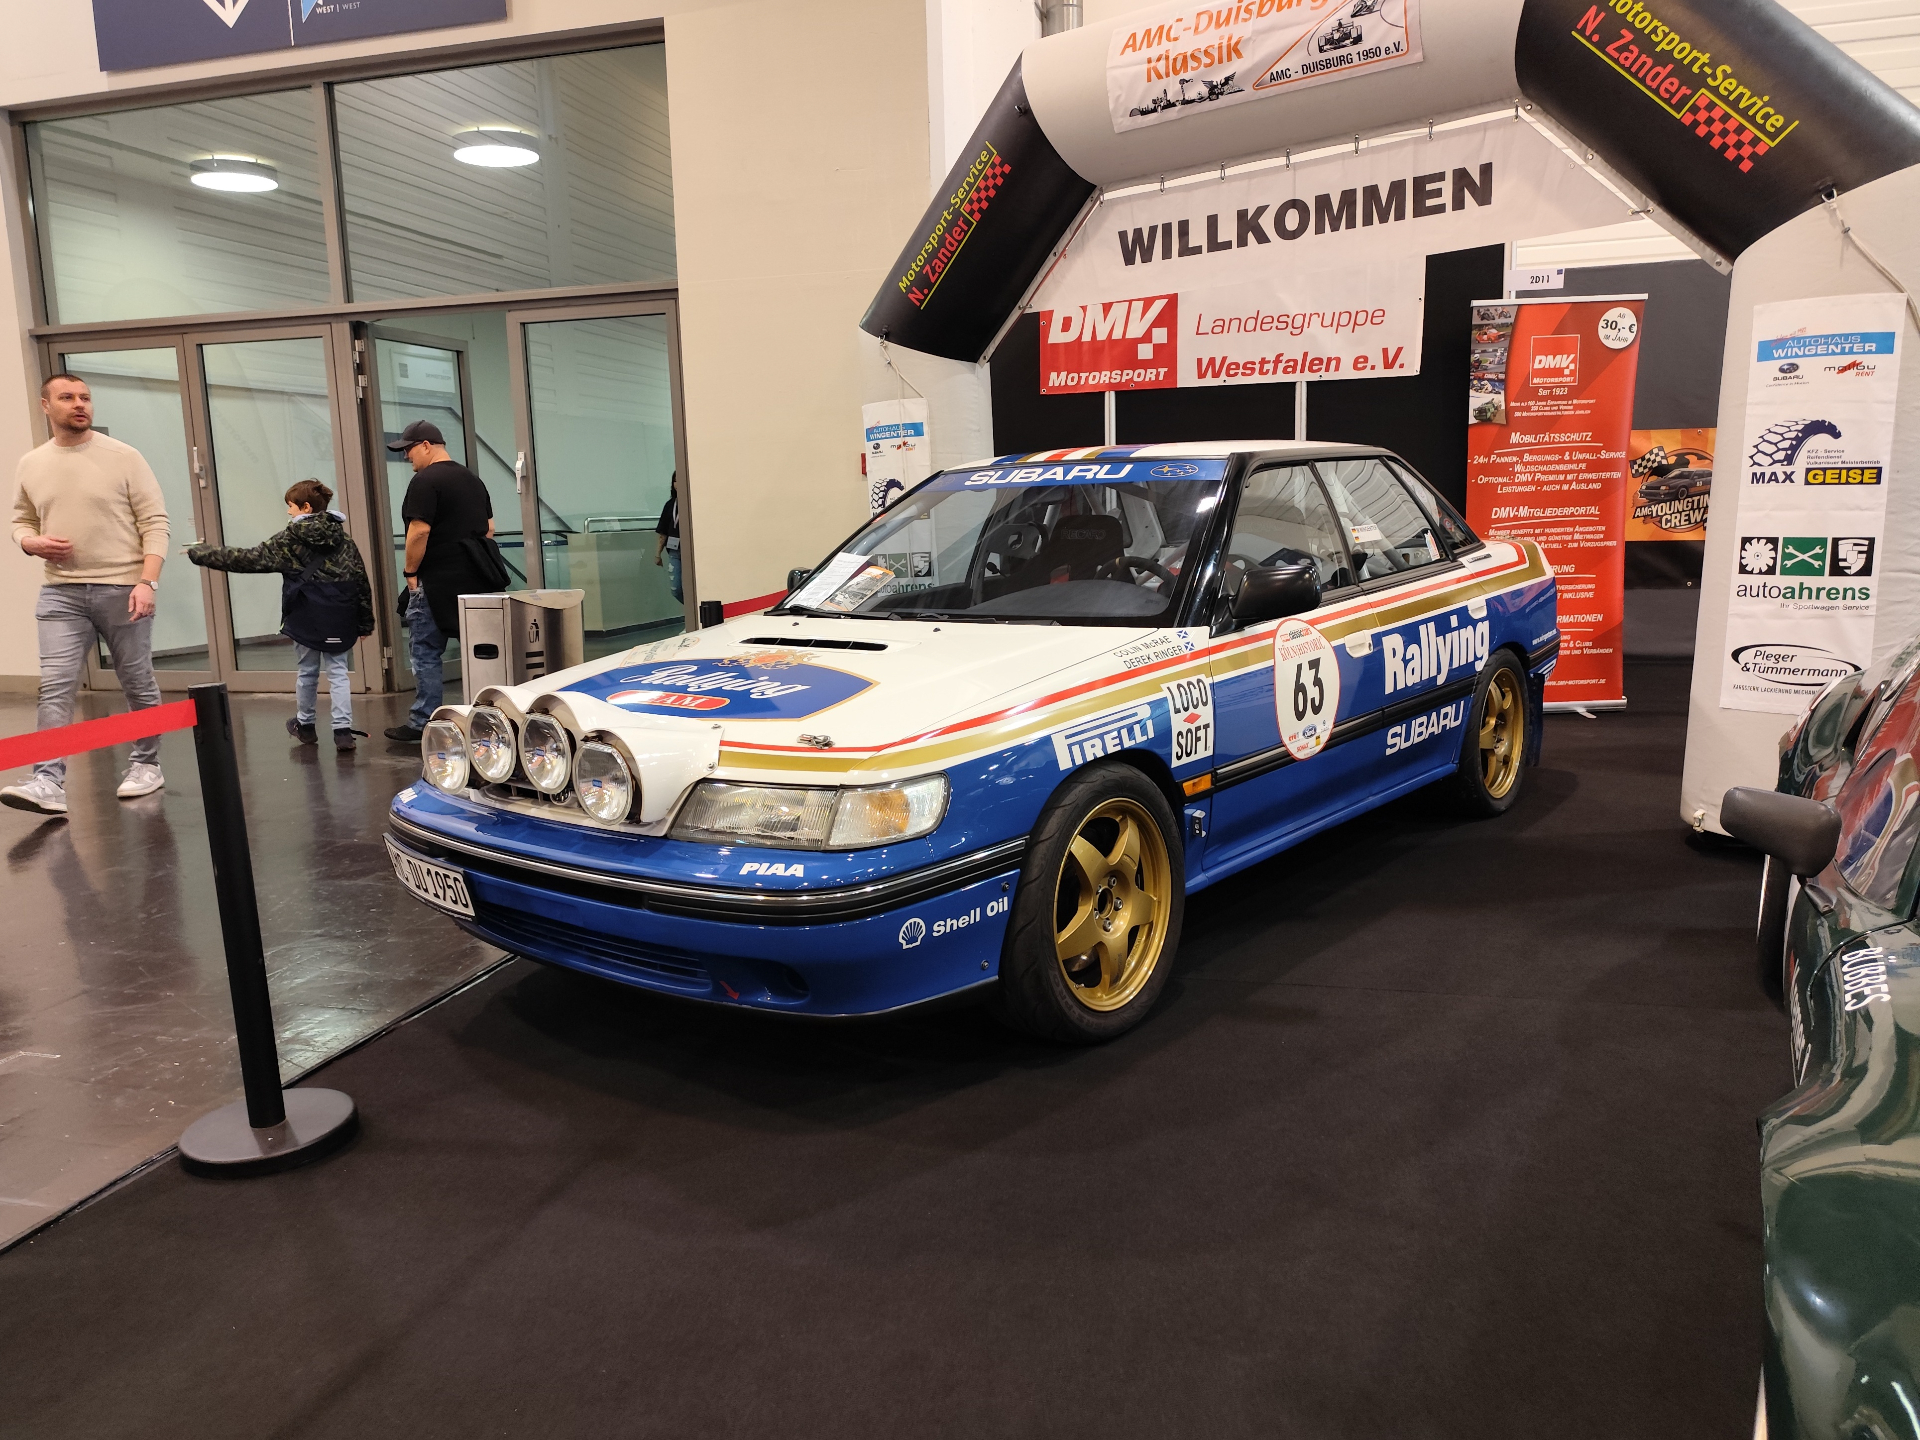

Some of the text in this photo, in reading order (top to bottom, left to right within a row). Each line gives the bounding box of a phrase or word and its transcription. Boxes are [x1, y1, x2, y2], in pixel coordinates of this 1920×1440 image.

[316, 2, 361, 14] WEST WEST
[1146, 33, 1244, 82] Klassik
[1269, 67, 1292, 84] AMC
[1301, 53, 1354, 76] DUISBURG
[1356, 46, 1382, 63] 1950
[1385, 41, 1404, 56] e.V.
[1576, 5, 1692, 105] N. Zander
[898, 149, 990, 293] Motorsport-Service
[1117, 161, 1493, 267] WILLKOMMEN
[907, 216, 969, 307] N. Zander
[1530, 275, 1550, 285] 2D11
[1047, 298, 1170, 345] DMV
[1195, 306, 1386, 337] Landesgruppe
[1628, 324, 1636, 334] €
[1772, 343, 1877, 358] WINGENTER
[1785, 335, 1861, 347] AUTOHAUS
[1195, 347, 1406, 380] Westfalen e.V.
[1533, 354, 1576, 369] DMV
[1047, 368, 1168, 388] MOTORSPORT
[1532, 377, 1575, 385] MOTORSPORT
[1538, 387, 1569, 396] SEIT 1923
[1509, 432, 1592, 444] MOBILITÄTSSCHUTZ
[1473, 455, 1488, 464] 24H
[1523, 453, 1561, 462] BERGUNGS-
[1564, 452, 1570, 460] &
[1572, 450, 1626, 459] UNFALL-SERVICE
[964, 464, 1134, 486] SUBARU
[1477, 475, 1513, 484] OPTIONAL:
[1515, 473, 1533, 482] DMV
[1535, 472, 1565, 481] PREMIUM
[1579, 472, 1621, 480] ERWEITERTEN
[1751, 469, 1878, 485] MAX GEISE
[1497, 484, 1536, 493] LEISTUNGEN
[1542, 483, 1560, 491] AUCH
[1570, 481, 1602, 491] AUSLAND
[1491, 506, 1600, 519] DMV-MITGLIEDERPORTAL
[1661, 508, 1705, 529] CREW
[1060, 529, 1107, 540] RECARO
[1574, 525, 1606, 533] ANGEBOTEN
[1736, 581, 1871, 601] autoahrens
[1793, 603, 1840, 611] Sportwagen
[1556, 614, 1603, 623] RMATIONEN
[1113, 645, 1142, 658] COLIN
[1123, 644, 1185, 669] DEREK RINGER
[1382, 614, 1490, 695] Rallying
[1753, 650, 1797, 664] Pleger
[619, 664, 812, 699] Rallying
[1293, 656, 1325, 722] 63
[1166, 677, 1209, 714] LOCO
[1050, 703, 1155, 772] PIRELLI
[1385, 700, 1464, 756] SUBARU
[1175, 722, 1211, 761] SOFT
[738, 862, 805, 878] PIAA
[427, 867, 469, 909] 1950
[932, 896, 1009, 937] Shell Oil
[1841, 946, 1898, 1011] BÜBBES
